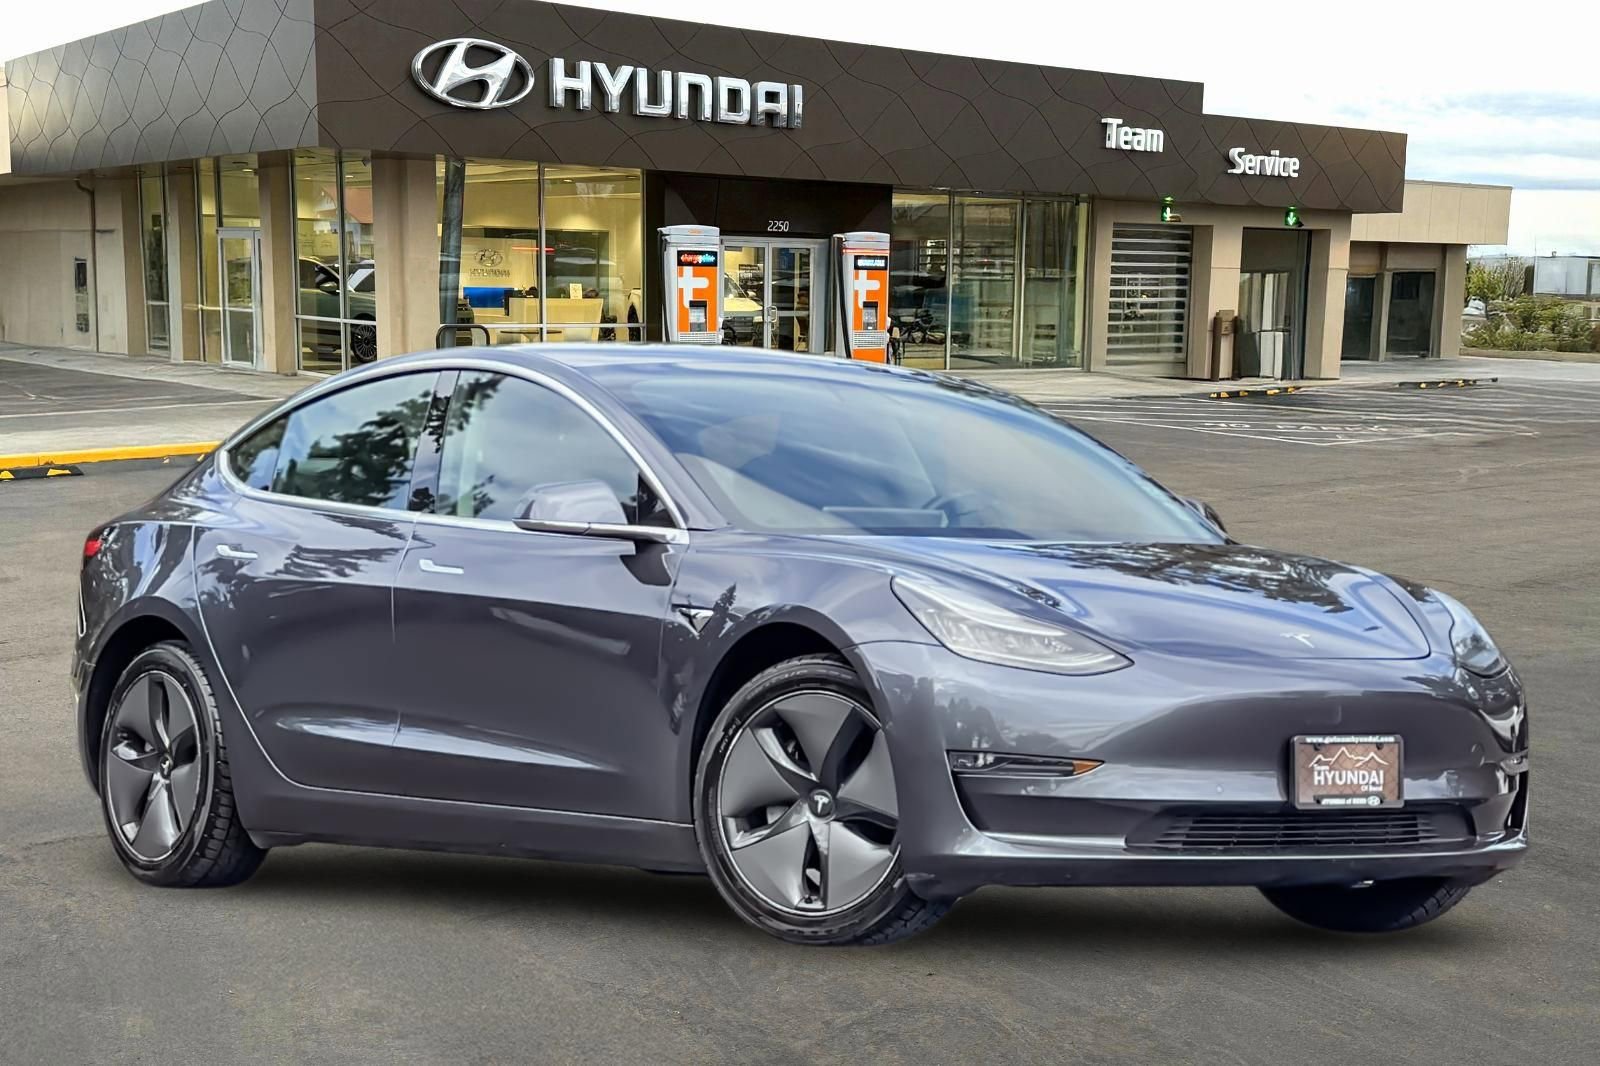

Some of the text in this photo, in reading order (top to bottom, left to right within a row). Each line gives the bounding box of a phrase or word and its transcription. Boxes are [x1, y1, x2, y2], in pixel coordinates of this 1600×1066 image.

[549, 57, 803, 129] HYUNDAI
[1101, 117, 1164, 153] Team
[1227, 147, 1300, 178] Service
[767, 220, 790, 232] 2250
[1313, 770, 1384, 785] HYUNDAI
